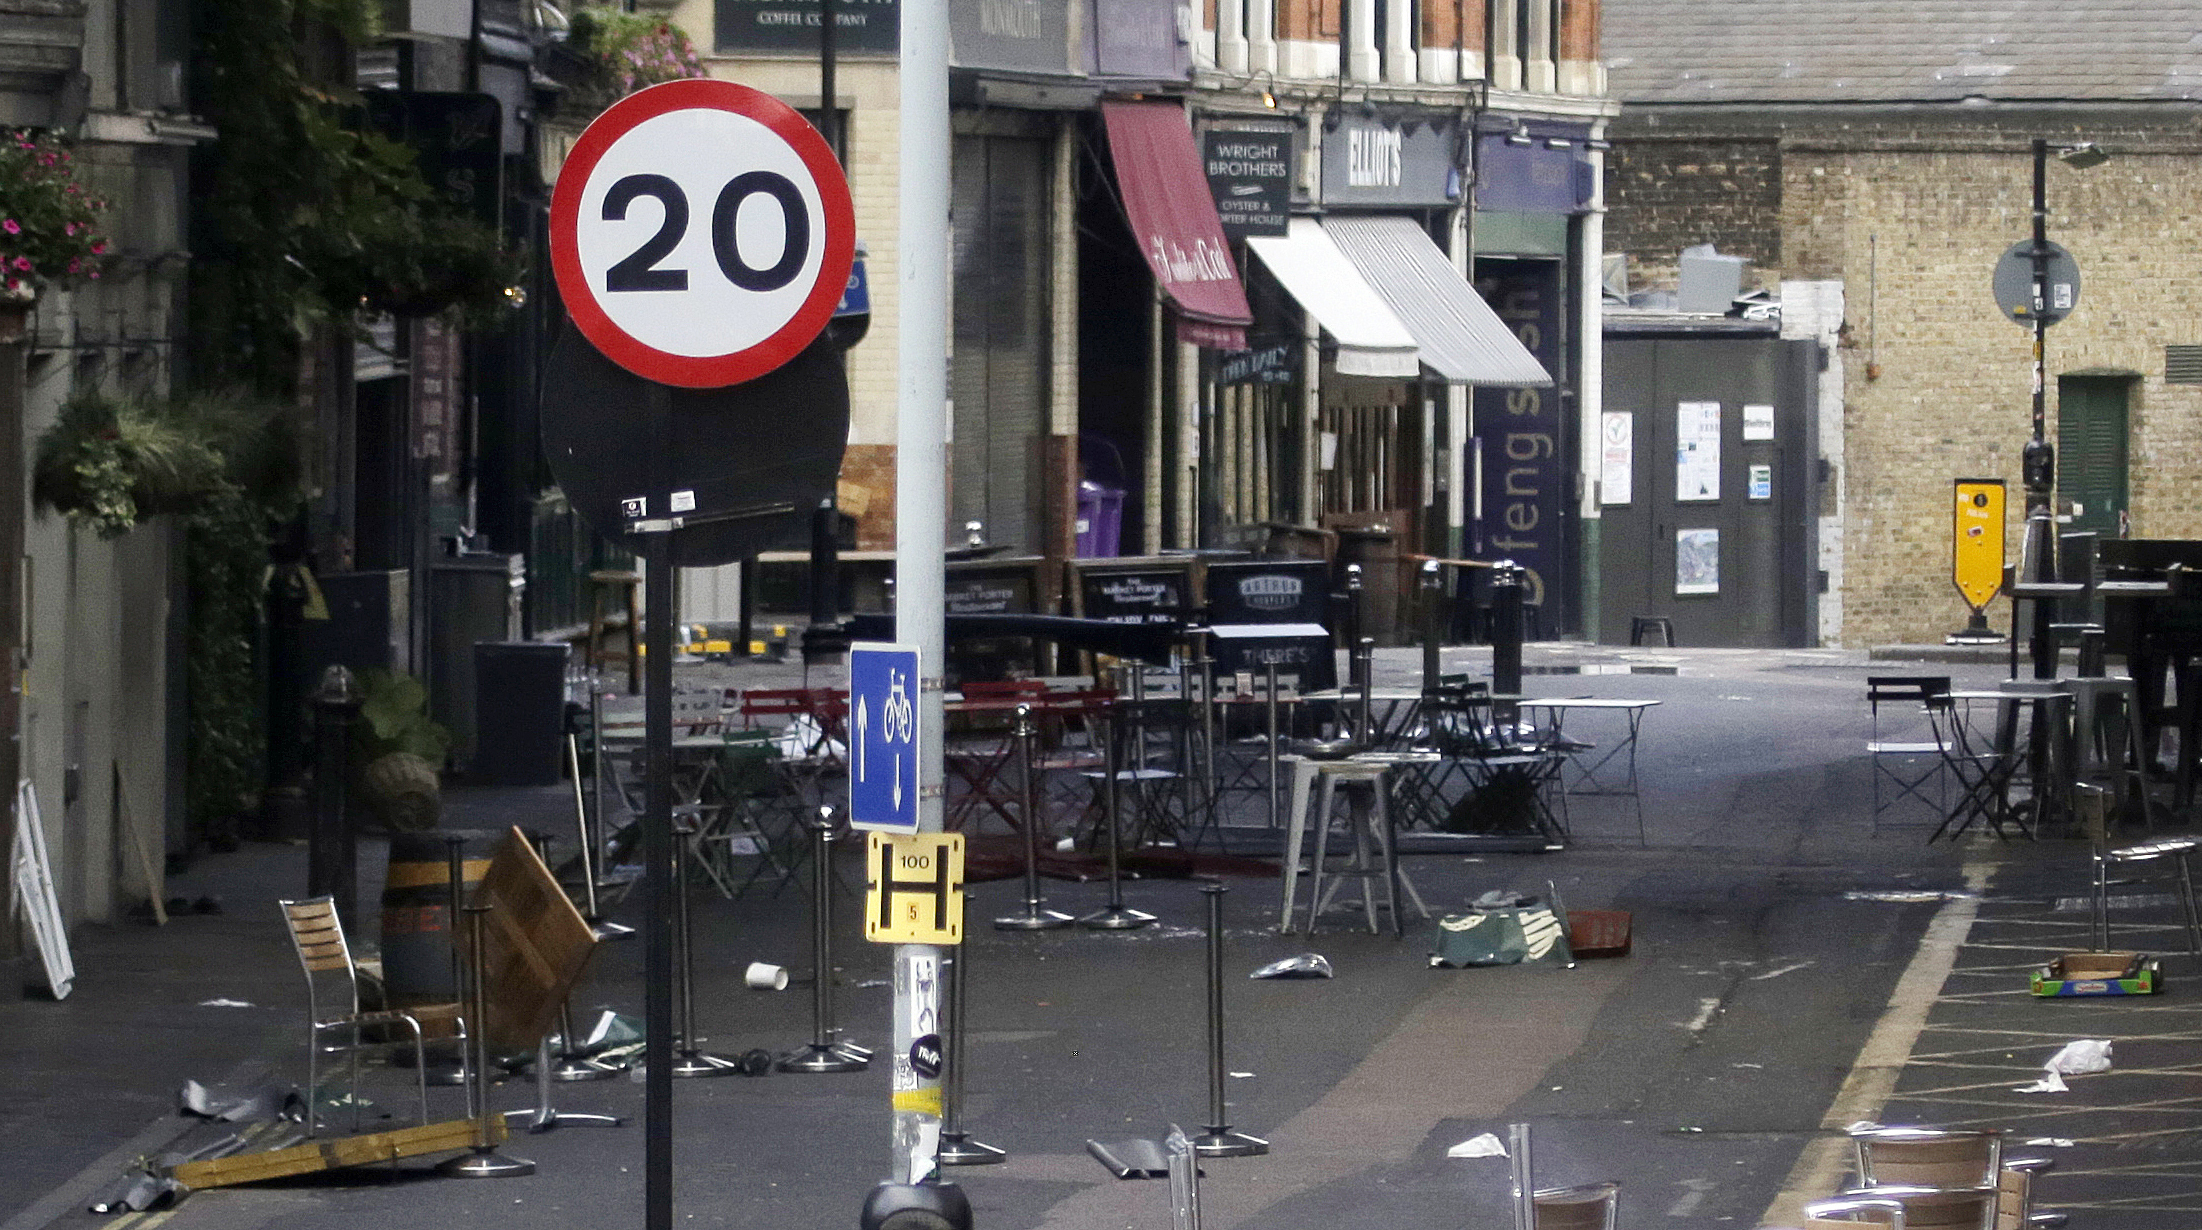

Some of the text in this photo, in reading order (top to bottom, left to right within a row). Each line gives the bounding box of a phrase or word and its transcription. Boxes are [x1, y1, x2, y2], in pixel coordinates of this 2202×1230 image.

[805, 12, 868, 27] COPANY
[1218, 144, 1278, 158] WRIGHT
[1208, 160, 1286, 177] BROTHERS
[1222, 200, 1260, 211] OYSTER
[1249, 214, 1285, 226] HOUSE
[602, 170, 810, 293] 20
[1491, 432, 1554, 552] feng
[901, 855, 930, 869] 100
[909, 904, 918, 921] 5
